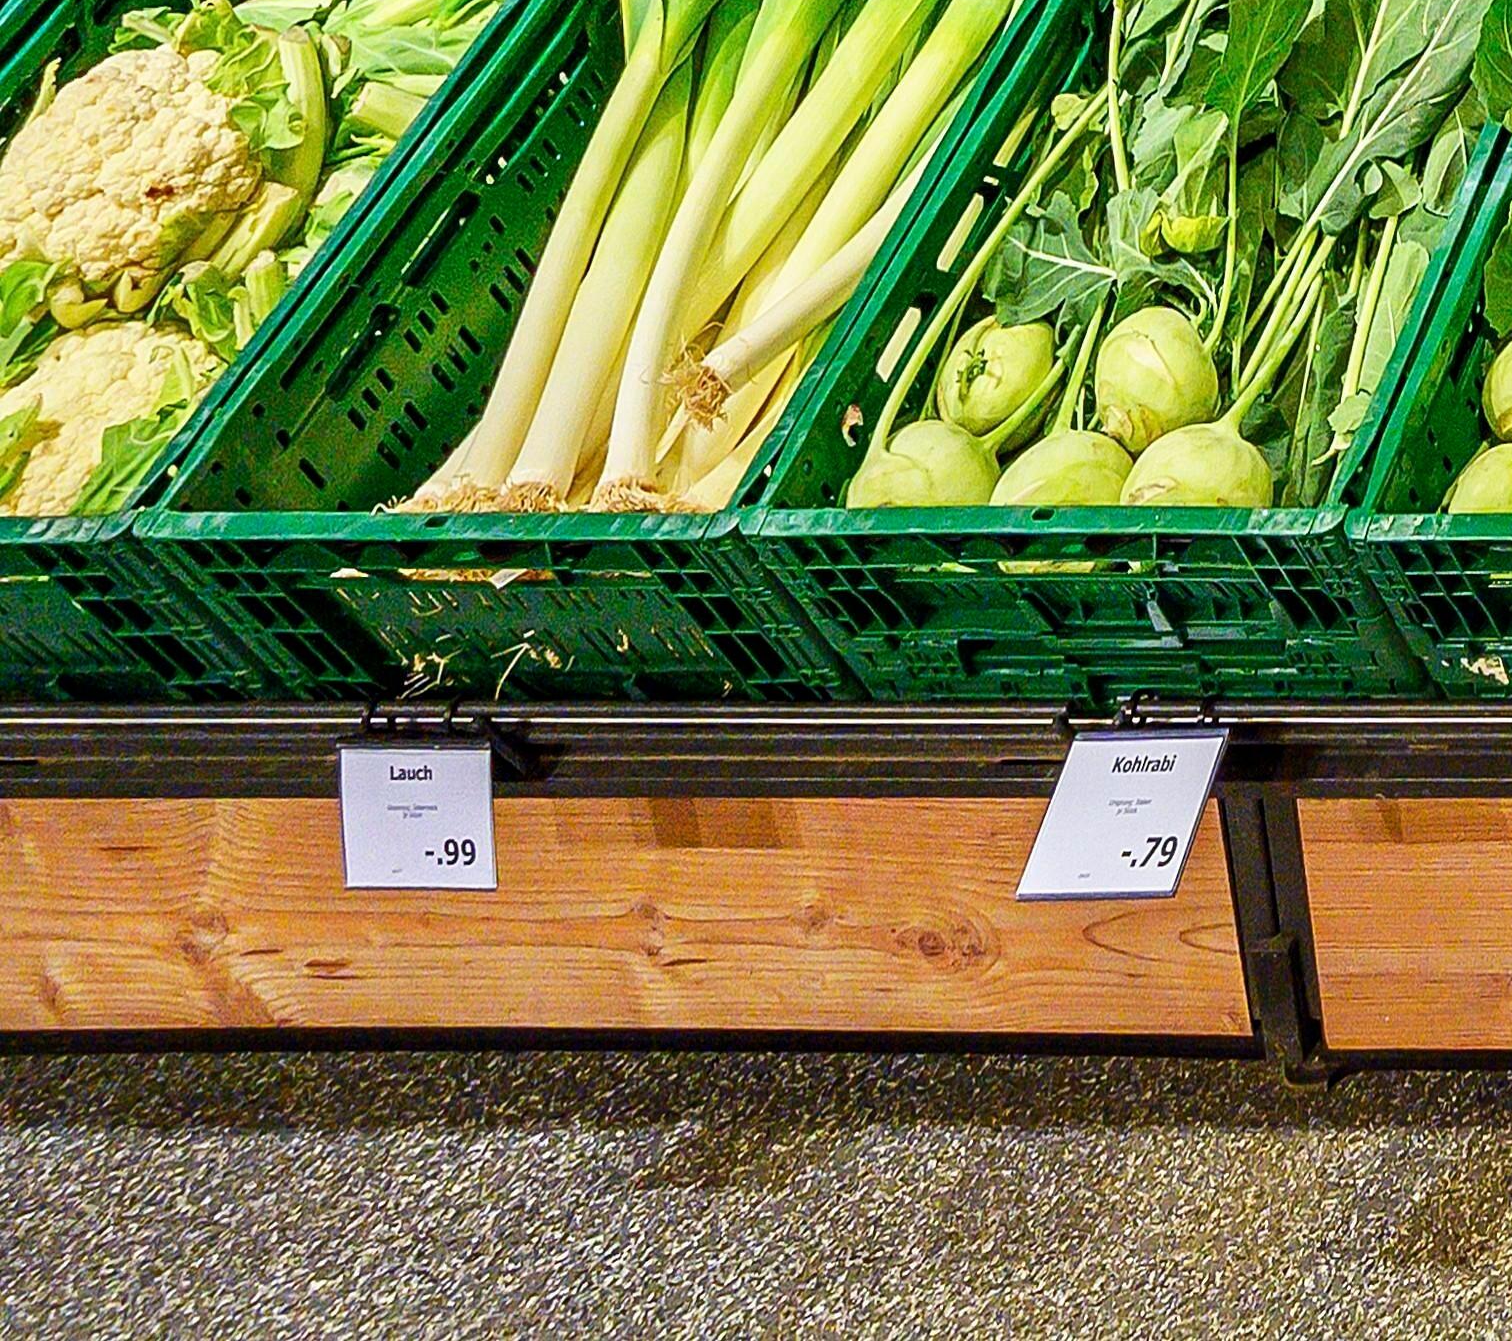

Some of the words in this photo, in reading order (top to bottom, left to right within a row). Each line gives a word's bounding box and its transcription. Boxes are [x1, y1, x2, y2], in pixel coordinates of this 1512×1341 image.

[389, 764, 433, 782] Lauch
[1111, 754, 1178, 774] Kohlrabi
[424, 838, 476, 866] -.99
[1121, 835, 1178, 868] -.79
